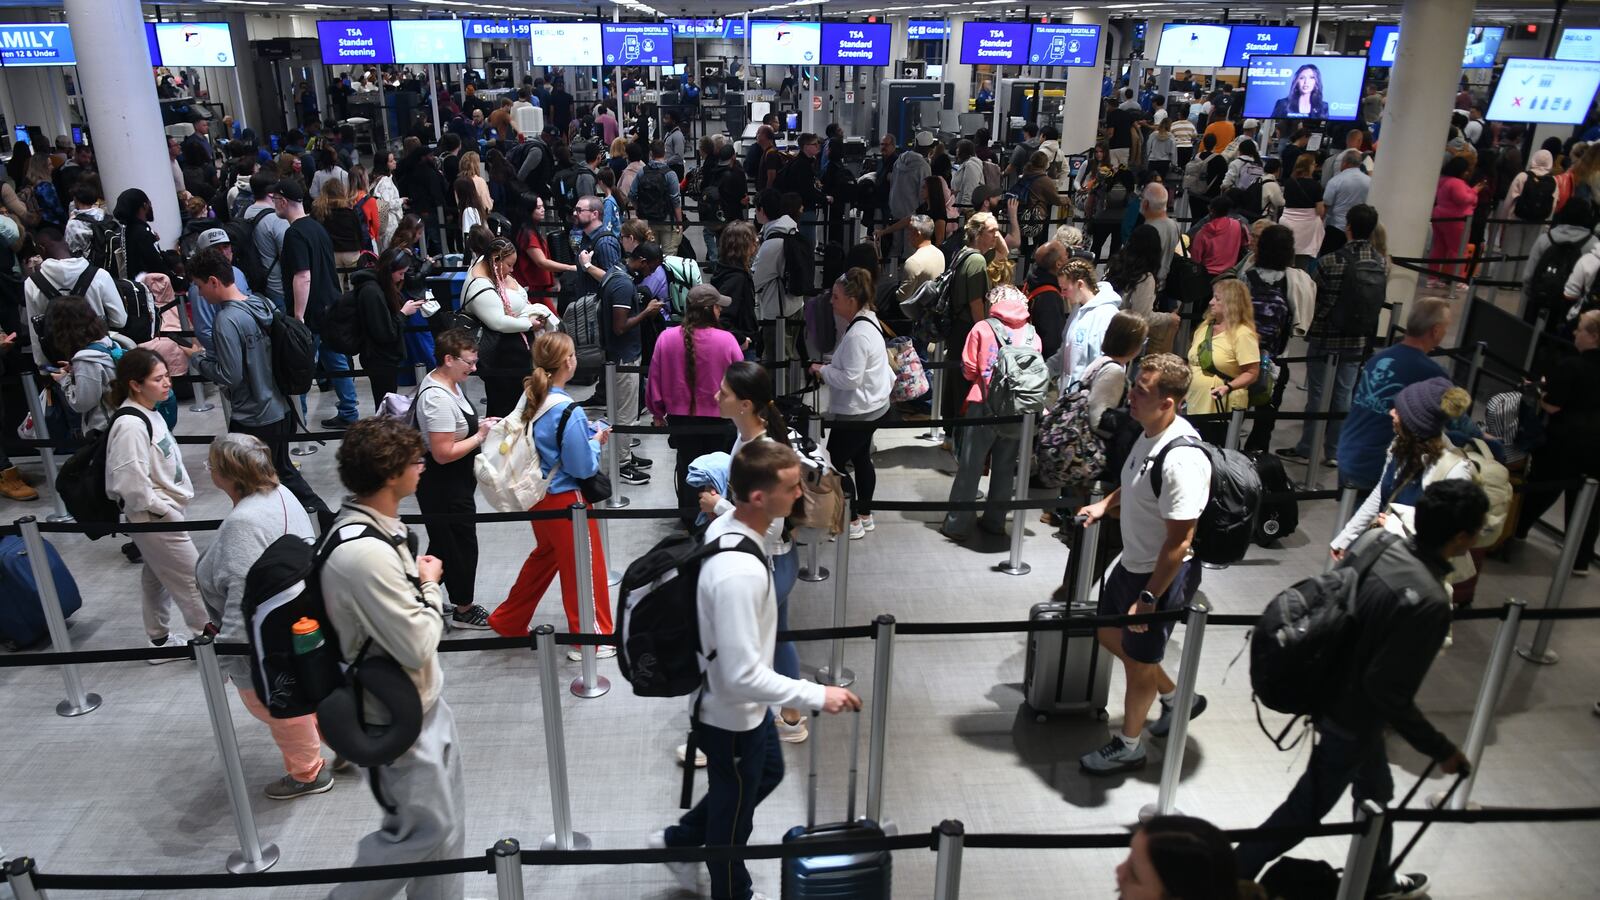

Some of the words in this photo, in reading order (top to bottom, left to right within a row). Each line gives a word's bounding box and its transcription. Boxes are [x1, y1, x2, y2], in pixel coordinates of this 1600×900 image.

[346, 28, 362, 37] TSA
[484, 25, 509, 34] Gates
[511, 25, 530, 34] 1-59
[926, 26, 944, 34] Gates
[989, 29, 1004, 38] TSA
[849, 30, 864, 39] TSA
[1257, 33, 1271, 41] TSA
[338, 38, 373, 46] Standard
[839, 40, 873, 49] Standard
[979, 39, 1012, 48] Standard
[1245, 43, 1279, 51] Standard
[338, 47, 376, 57] Screening
[837, 50, 873, 60] Screening
[977, 49, 1012, 59] Screening
[1247, 67, 1280, 77] REAL
[1279, 68, 1293, 78] ID
